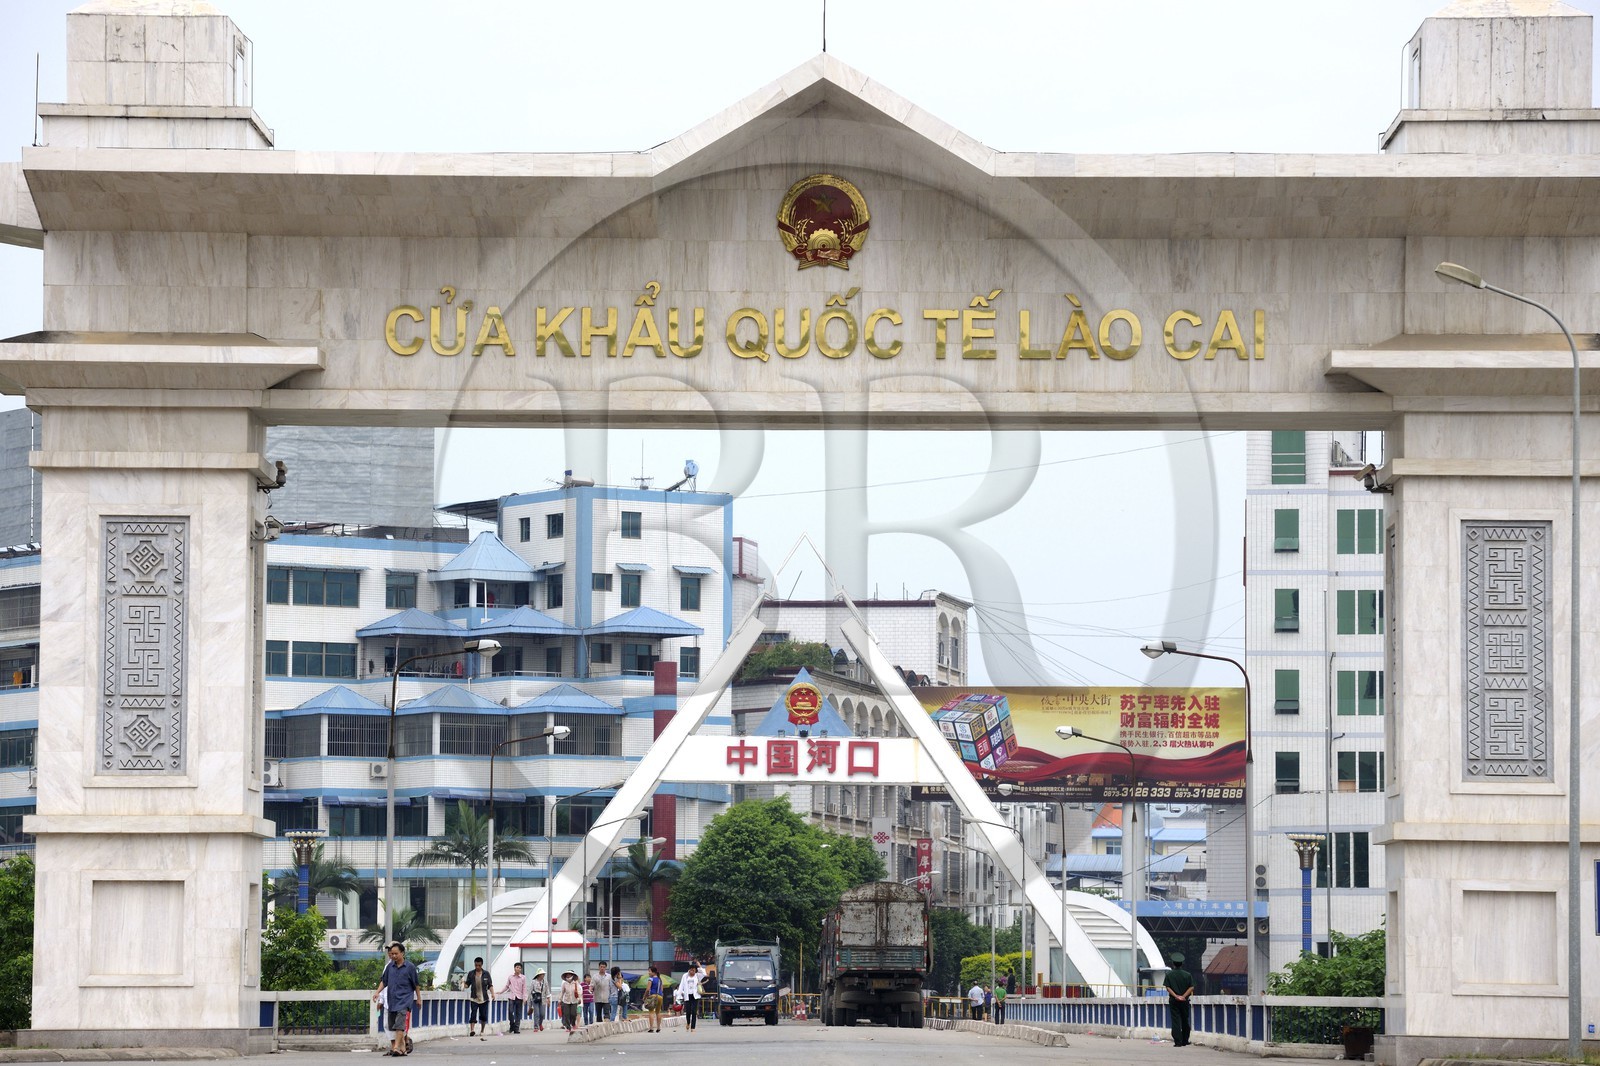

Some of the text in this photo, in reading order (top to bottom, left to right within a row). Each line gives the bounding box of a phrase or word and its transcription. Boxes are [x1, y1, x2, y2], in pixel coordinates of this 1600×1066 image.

[384, 280, 1266, 363] CỬA KHẨU QUỐC TẾ LÀO CAI
[1120, 694, 1220, 711] 苏宁率先入驻
[1120, 712, 1220, 729] 财富辐射全城
[726, 738, 879, 777] 中国河口
[1150, 787, 1171, 798] 333
[1174, 788, 1243, 799] 0873-3192 888
